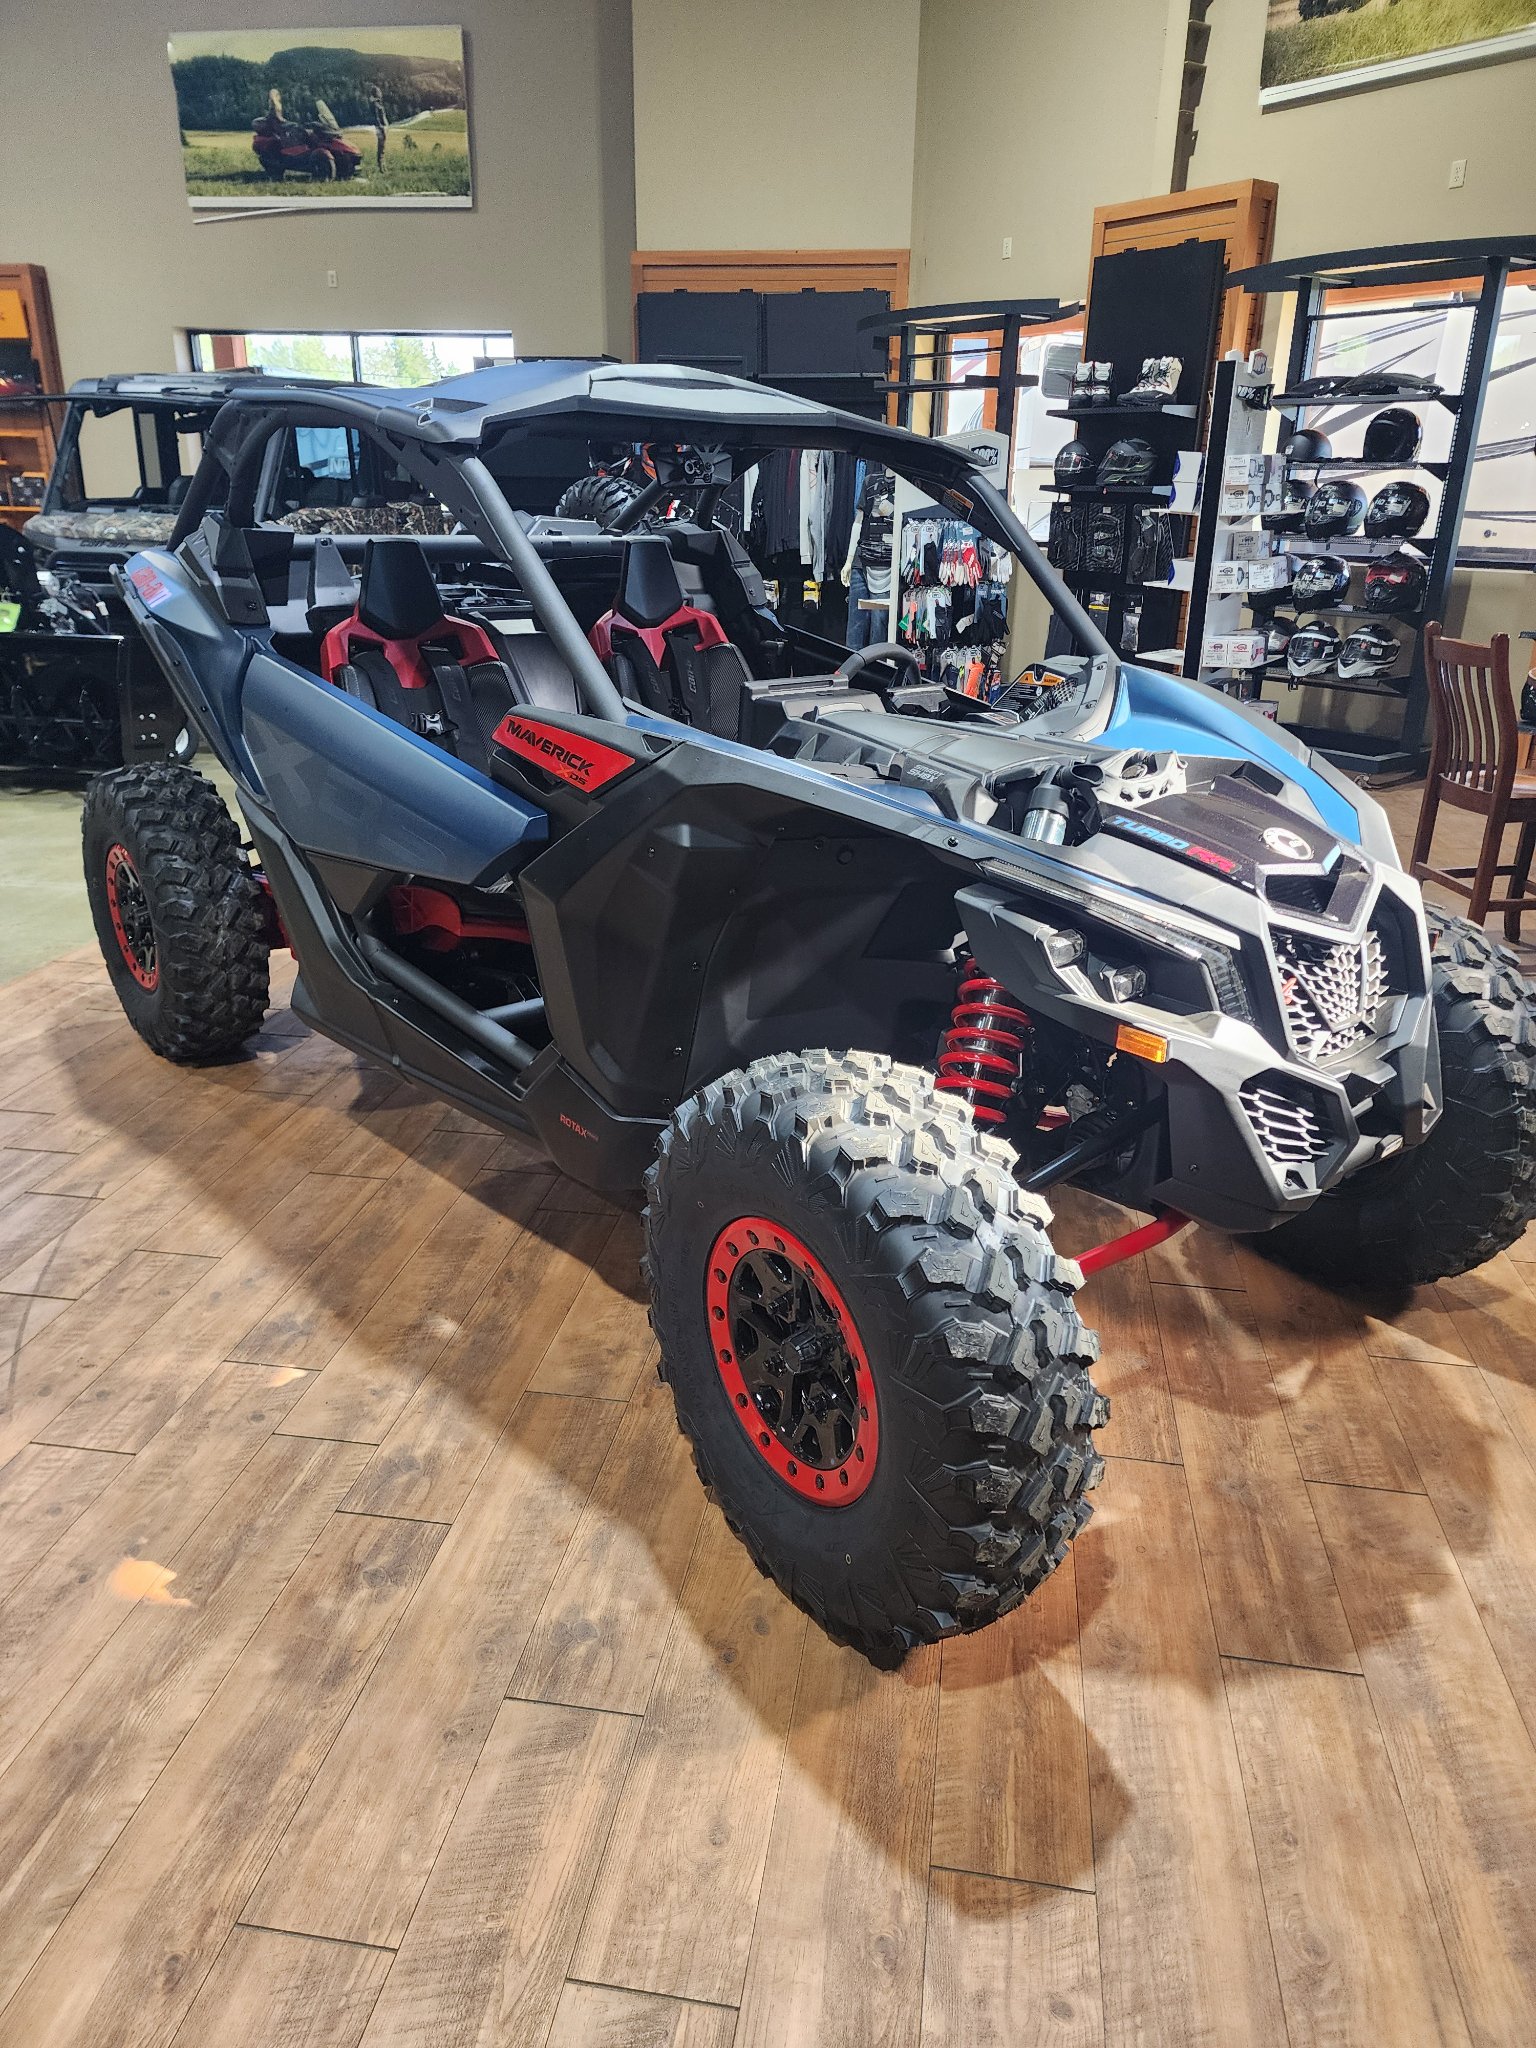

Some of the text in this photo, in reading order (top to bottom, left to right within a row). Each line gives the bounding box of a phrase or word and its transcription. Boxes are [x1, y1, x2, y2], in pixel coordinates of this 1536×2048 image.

[507, 719, 595, 776] MAVERICK
[1112, 815, 1190, 851] TURBO
[560, 1113, 587, 1139] ROTAX
